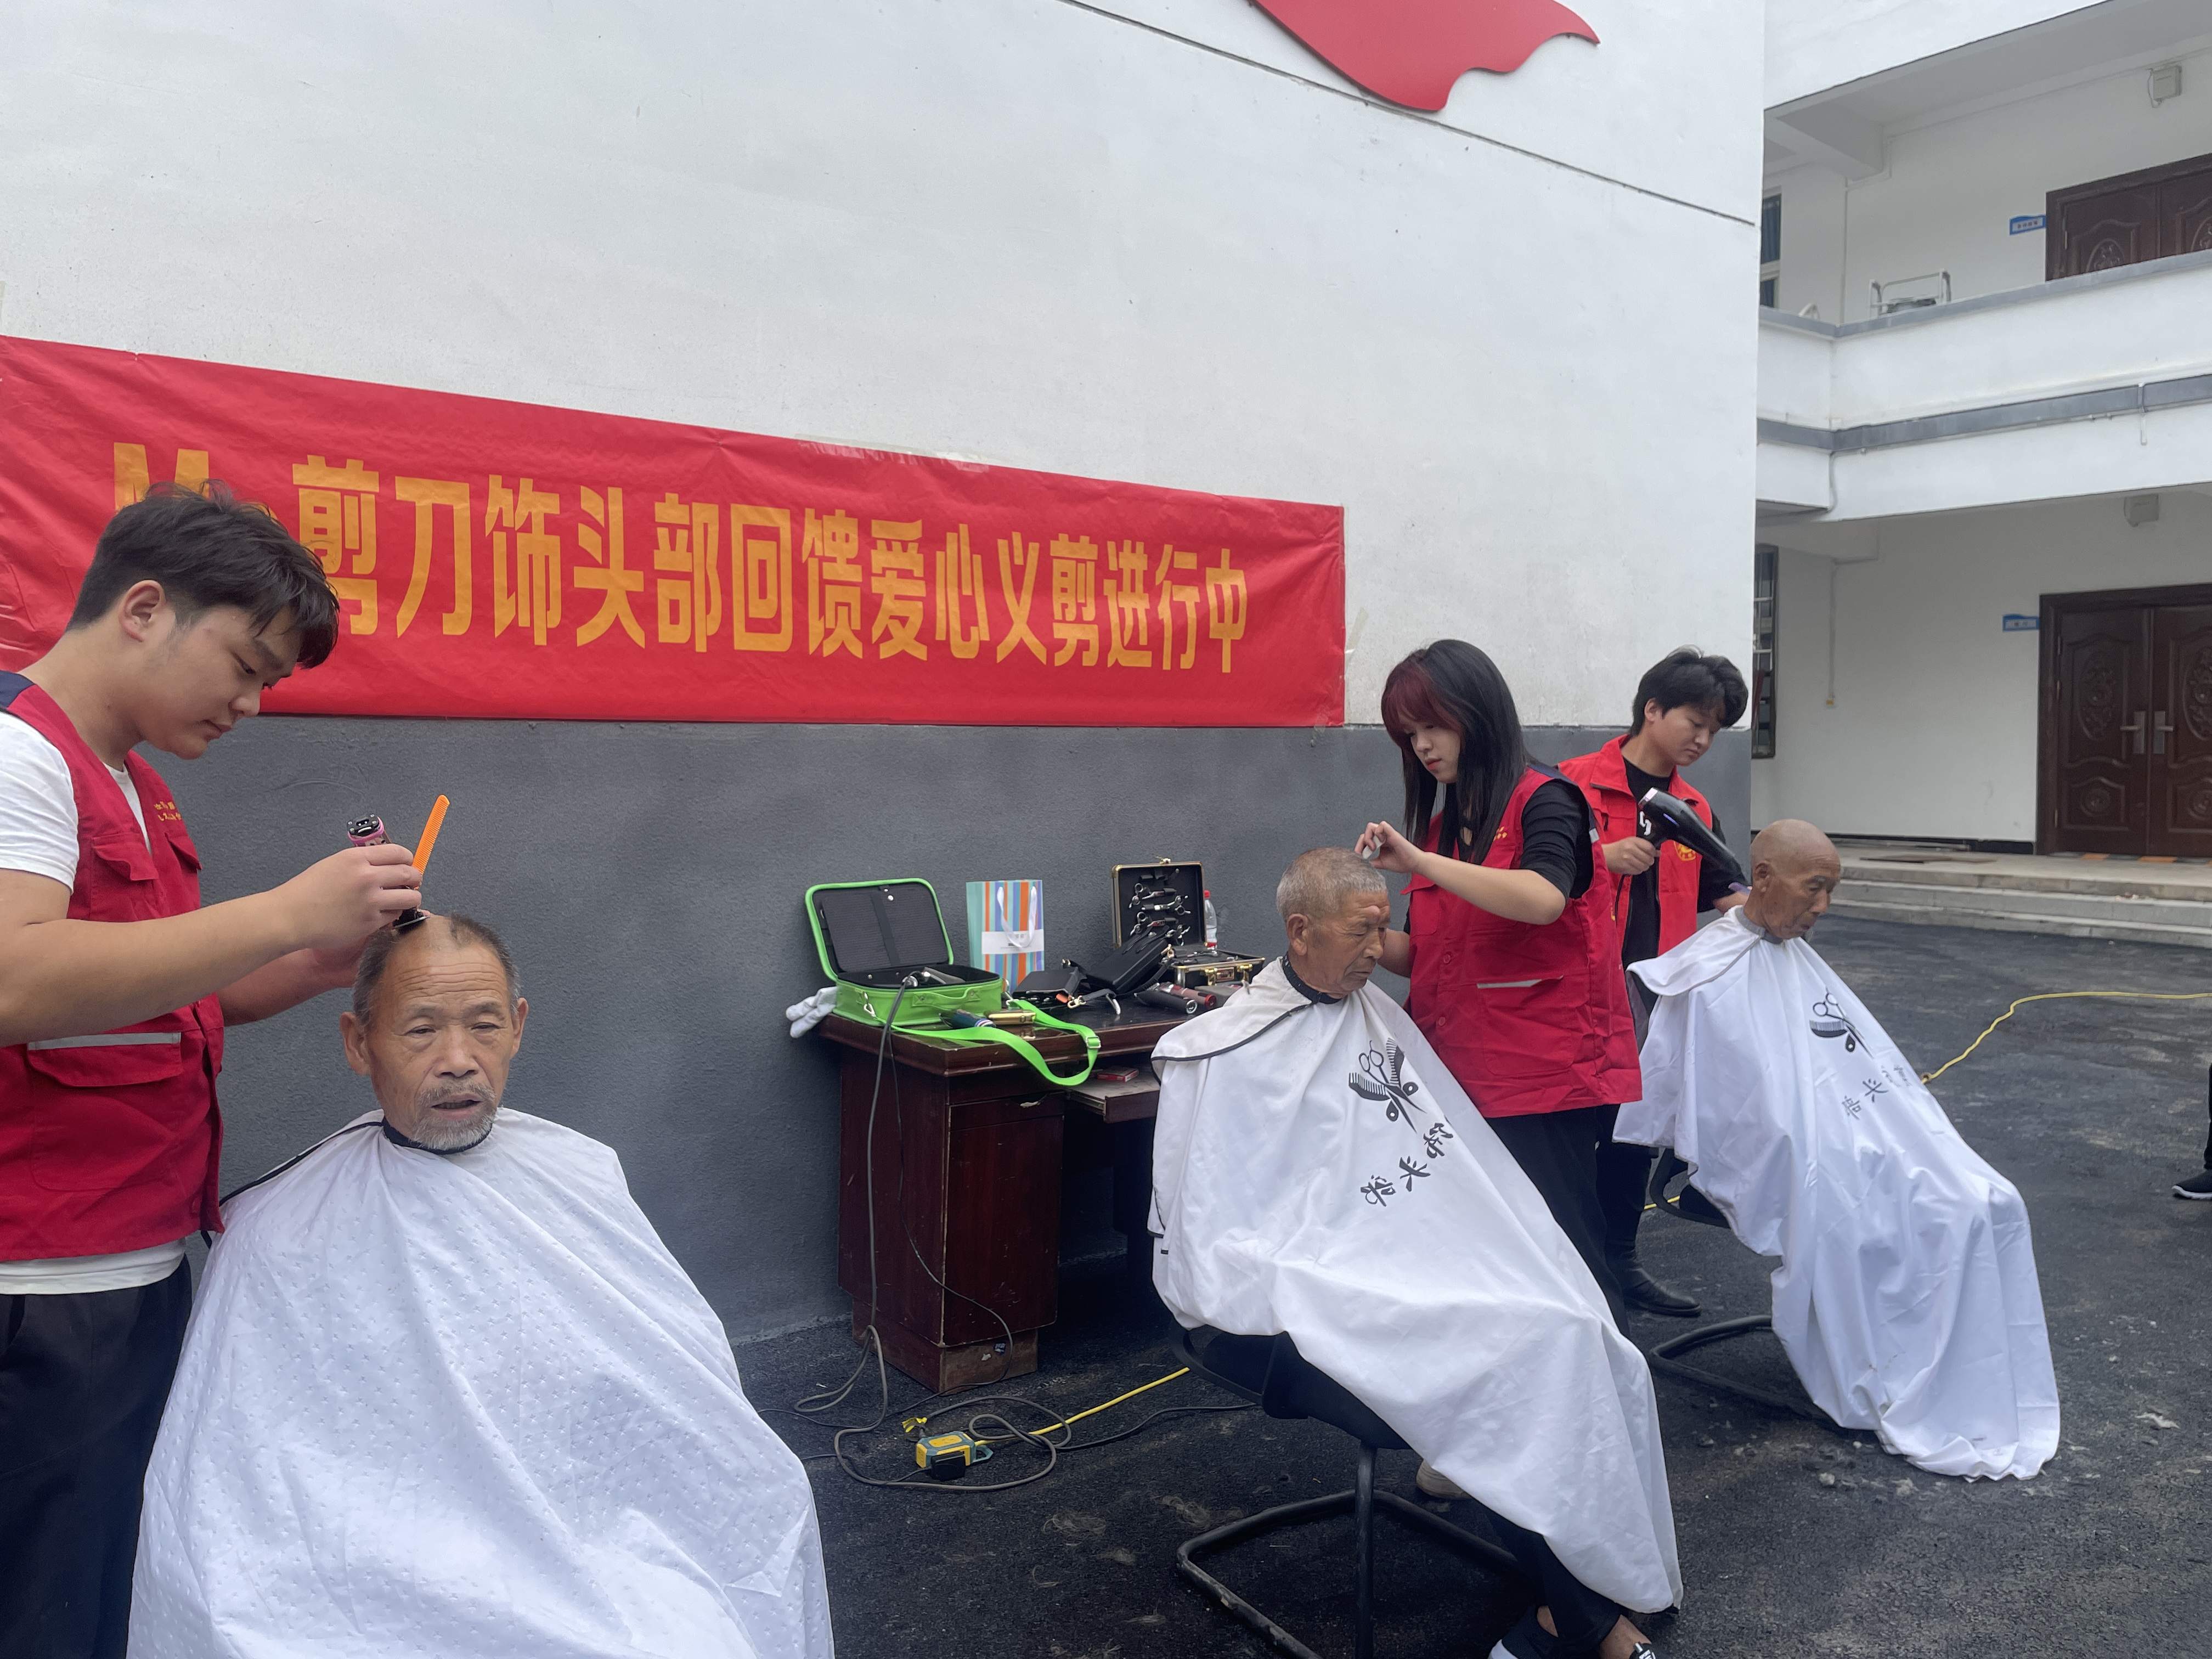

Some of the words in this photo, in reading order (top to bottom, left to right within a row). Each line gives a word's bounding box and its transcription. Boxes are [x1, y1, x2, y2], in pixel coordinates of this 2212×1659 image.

[114, 443, 1247, 673] 剪刀饰头部回馈爱心义剪进行中
